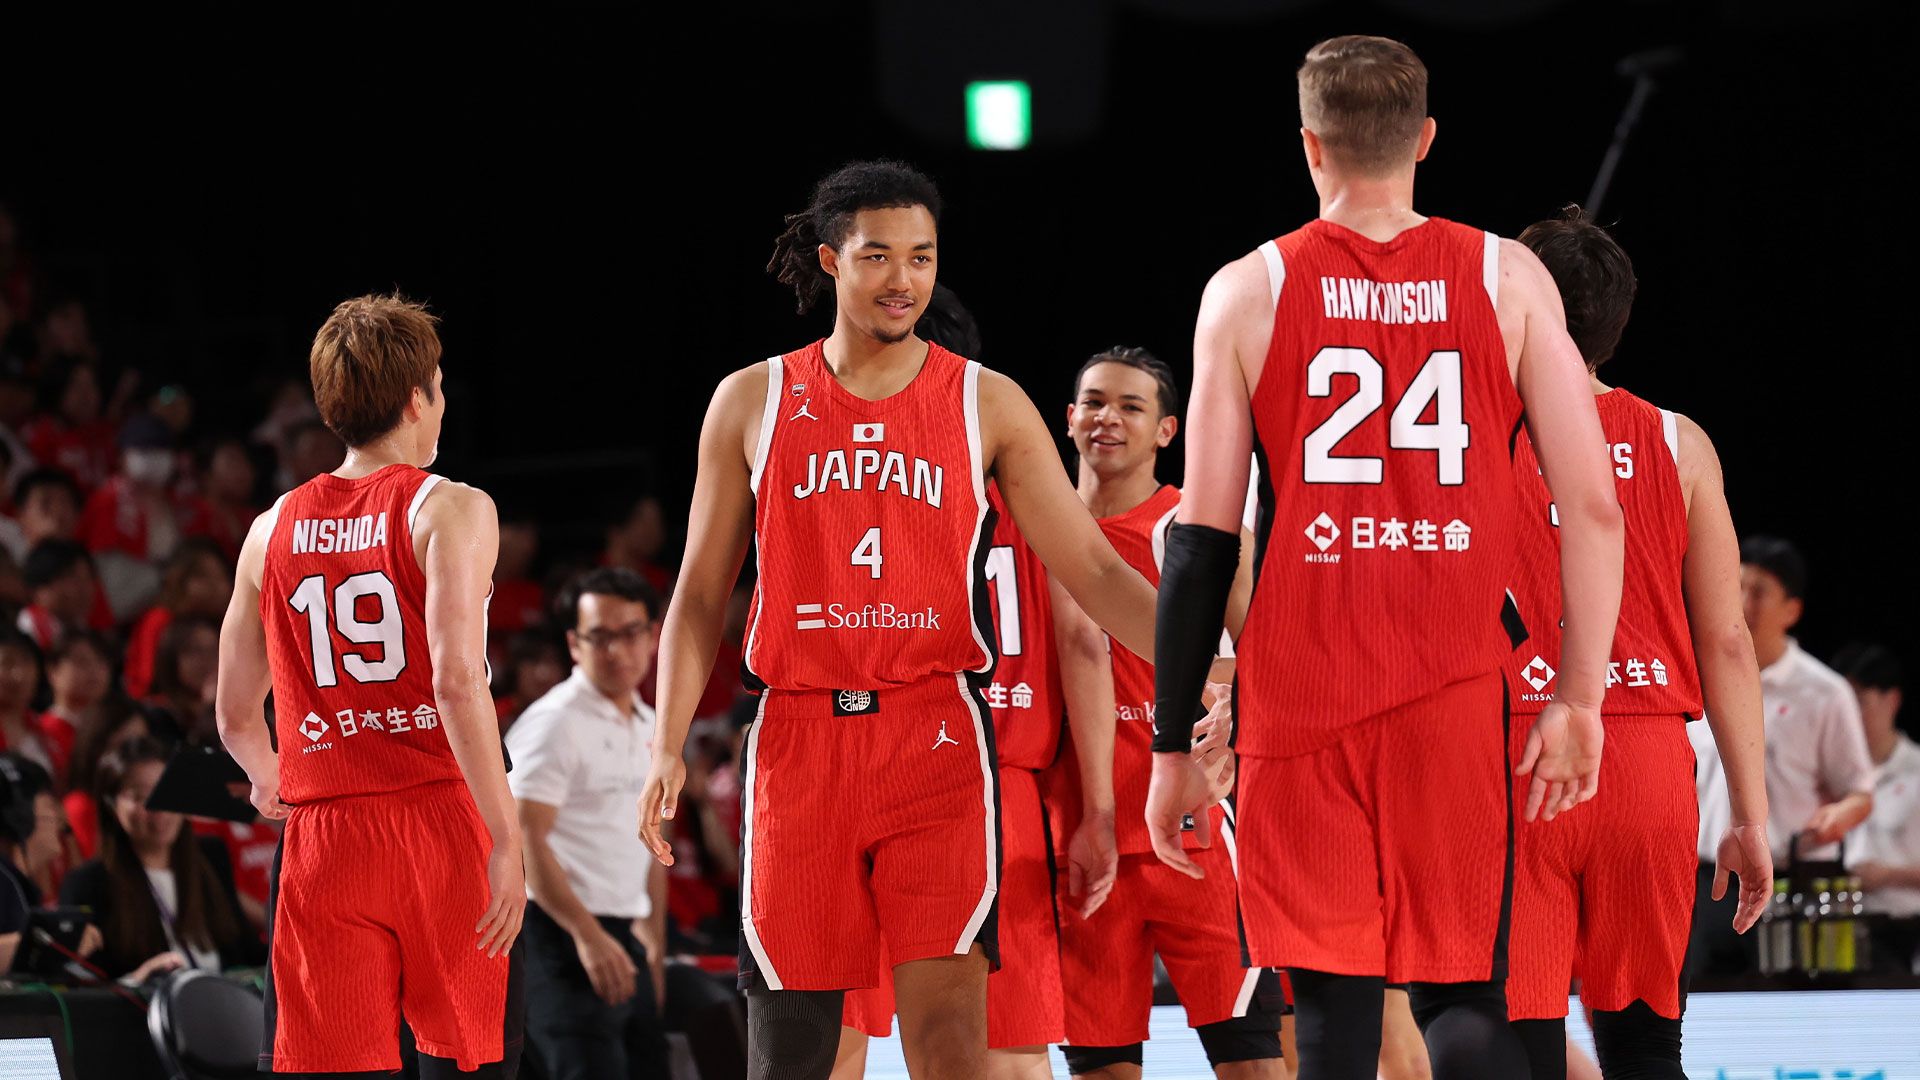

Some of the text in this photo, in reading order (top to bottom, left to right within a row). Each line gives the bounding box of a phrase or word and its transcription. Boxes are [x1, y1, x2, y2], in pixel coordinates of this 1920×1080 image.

[1320, 276, 1447, 324] HAWKINSON
[1303, 346, 1470, 486] 24
[793, 449, 943, 509] JAPAN
[292, 512, 386, 554] NISHIDA
[1352, 517, 1471, 552] 日本生命
[851, 527, 883, 579] 4
[1305, 553, 1341, 564] NISSAY
[827, 603, 941, 630] SoftBank
[985, 546, 1022, 656] 1
[288, 570, 406, 688] 19
[1604, 658, 1669, 689] 本生命
[988, 682, 1034, 709] 生命
[336, 703, 438, 737] 日本生命
[303, 742, 332, 755] NISSAY
